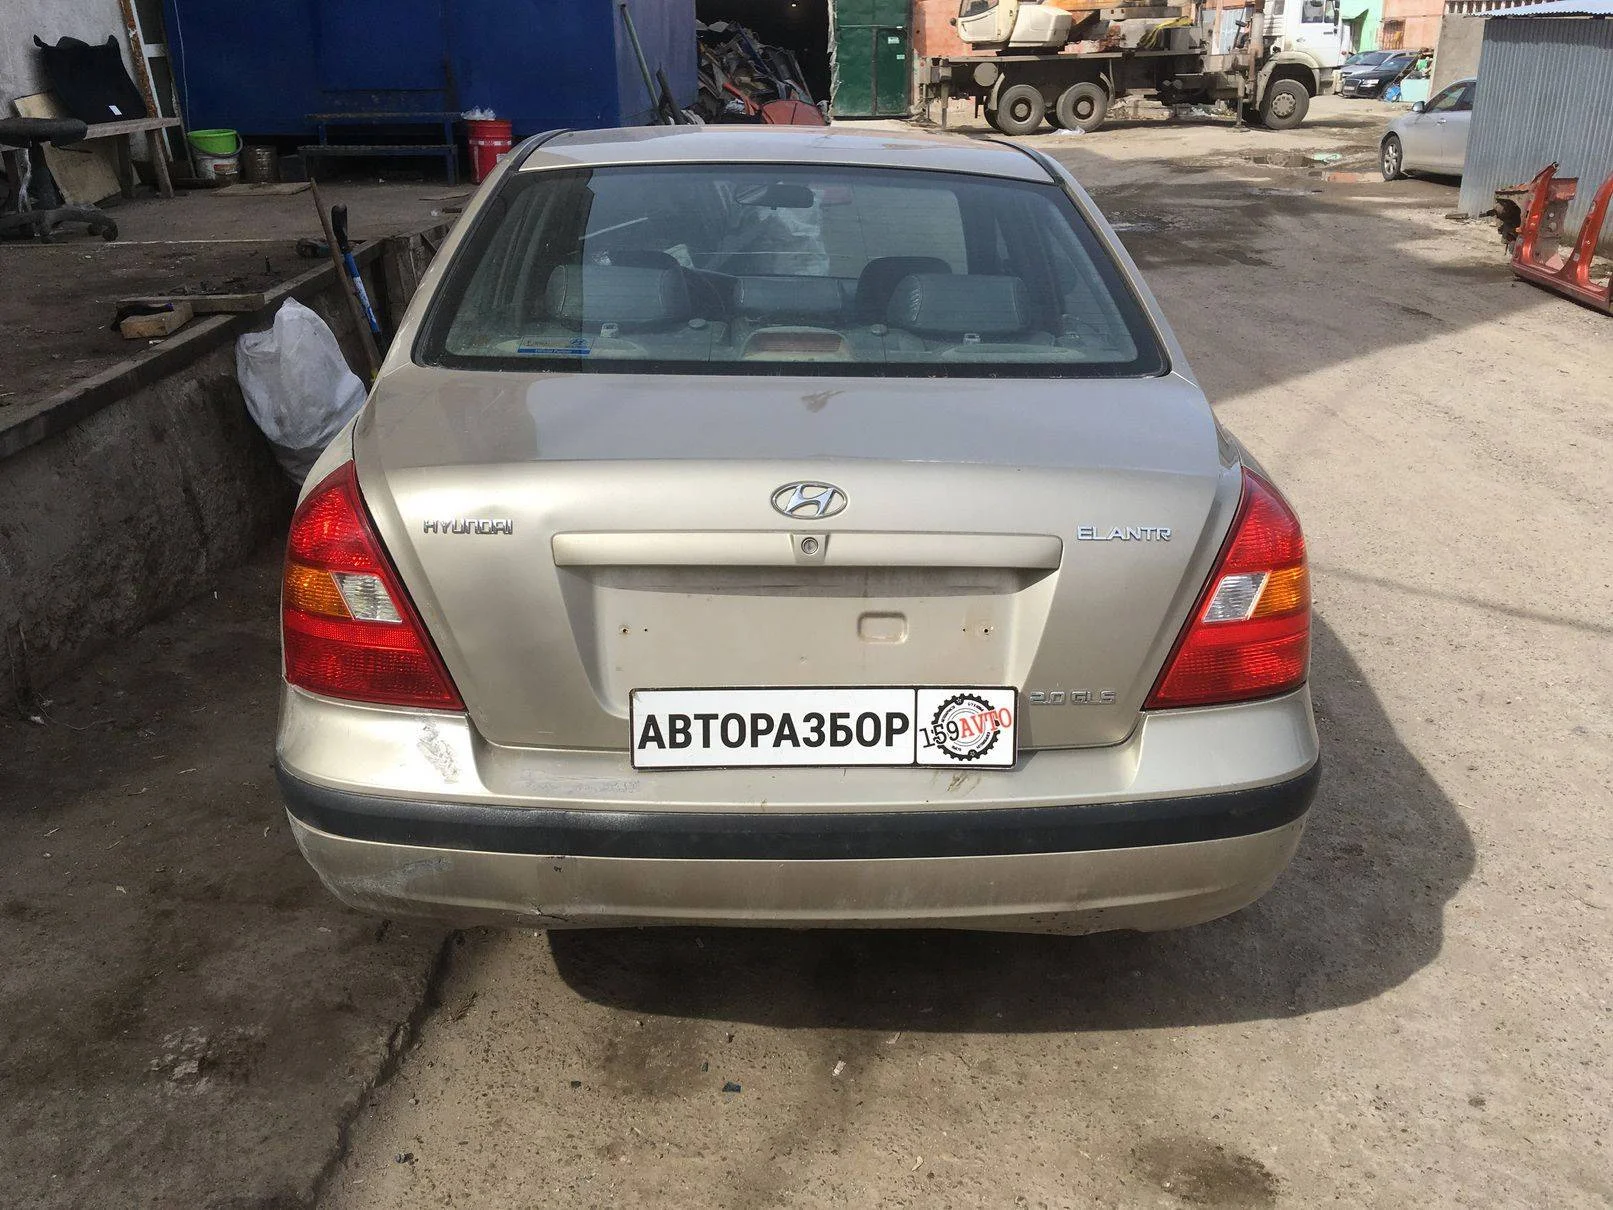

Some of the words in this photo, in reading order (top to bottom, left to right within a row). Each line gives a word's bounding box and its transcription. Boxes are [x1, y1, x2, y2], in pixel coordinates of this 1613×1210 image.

[423, 518, 513, 535] HYUNDAI
[1077, 525, 1172, 541] ELANTR
[1070, 690, 1117, 705] GLS
[637, 711, 910, 750] АВТОРАЗБОР
